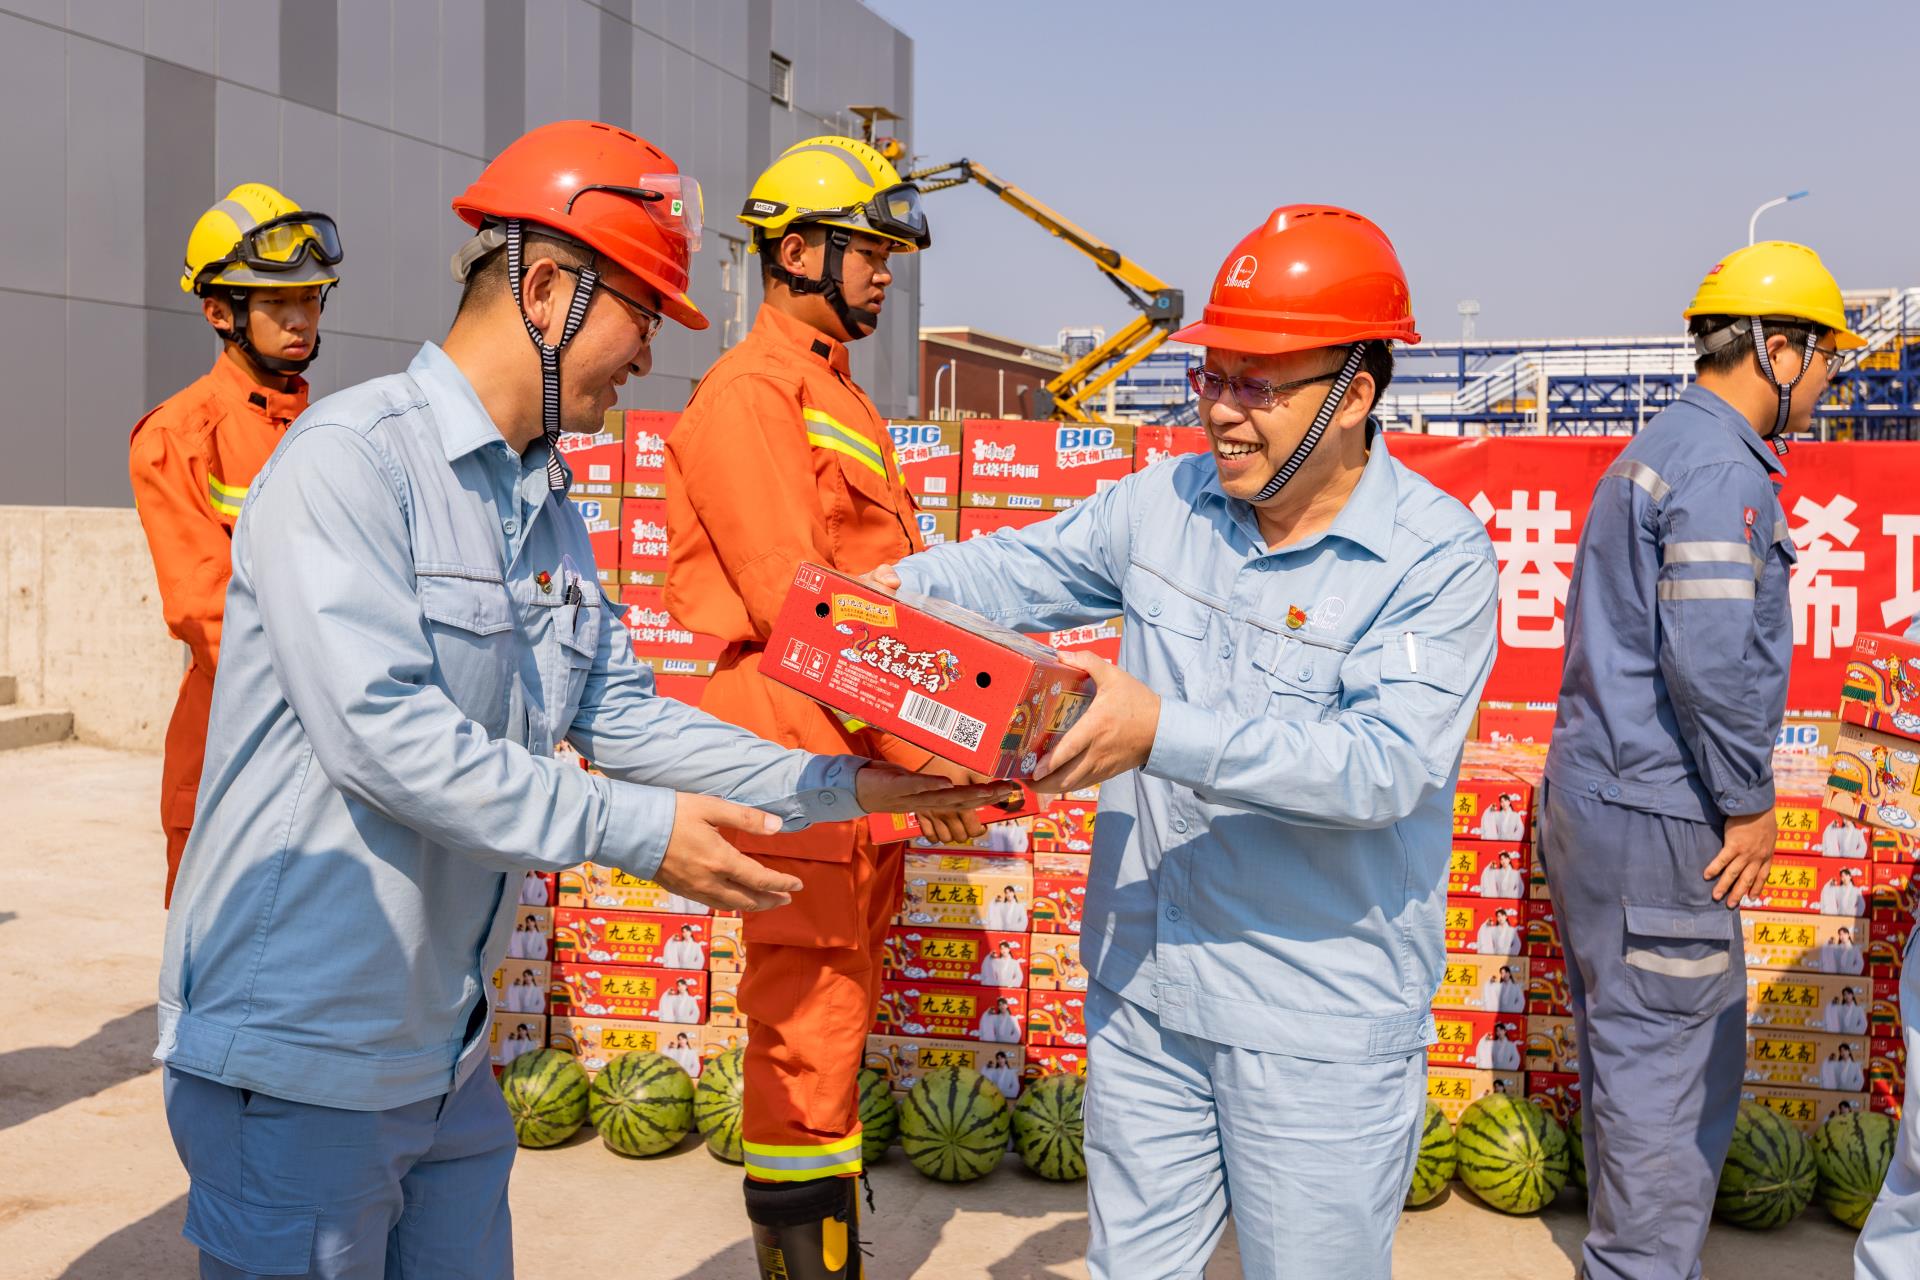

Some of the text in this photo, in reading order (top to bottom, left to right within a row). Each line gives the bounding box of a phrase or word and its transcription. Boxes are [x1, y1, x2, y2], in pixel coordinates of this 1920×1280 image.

[888, 426, 941, 446] BIG
[1060, 429, 1113, 449] BIG
[972, 462, 1039, 479] 红烧牛肉面
[1468, 489, 1577, 649] 港
[929, 885, 979, 905] 九龙斋
[608, 924, 656, 943] 九龙斋
[1758, 925, 1810, 945] 九龙斋
[924, 941, 973, 960] 九龙斋
[604, 978, 651, 997] 九龙斋
[1761, 986, 1815, 1007] 九龙斋
[922, 997, 971, 1016] 九龙斋
[605, 1032, 653, 1051] 九龙斋
[1759, 1041, 1811, 1062] 九龙斋
